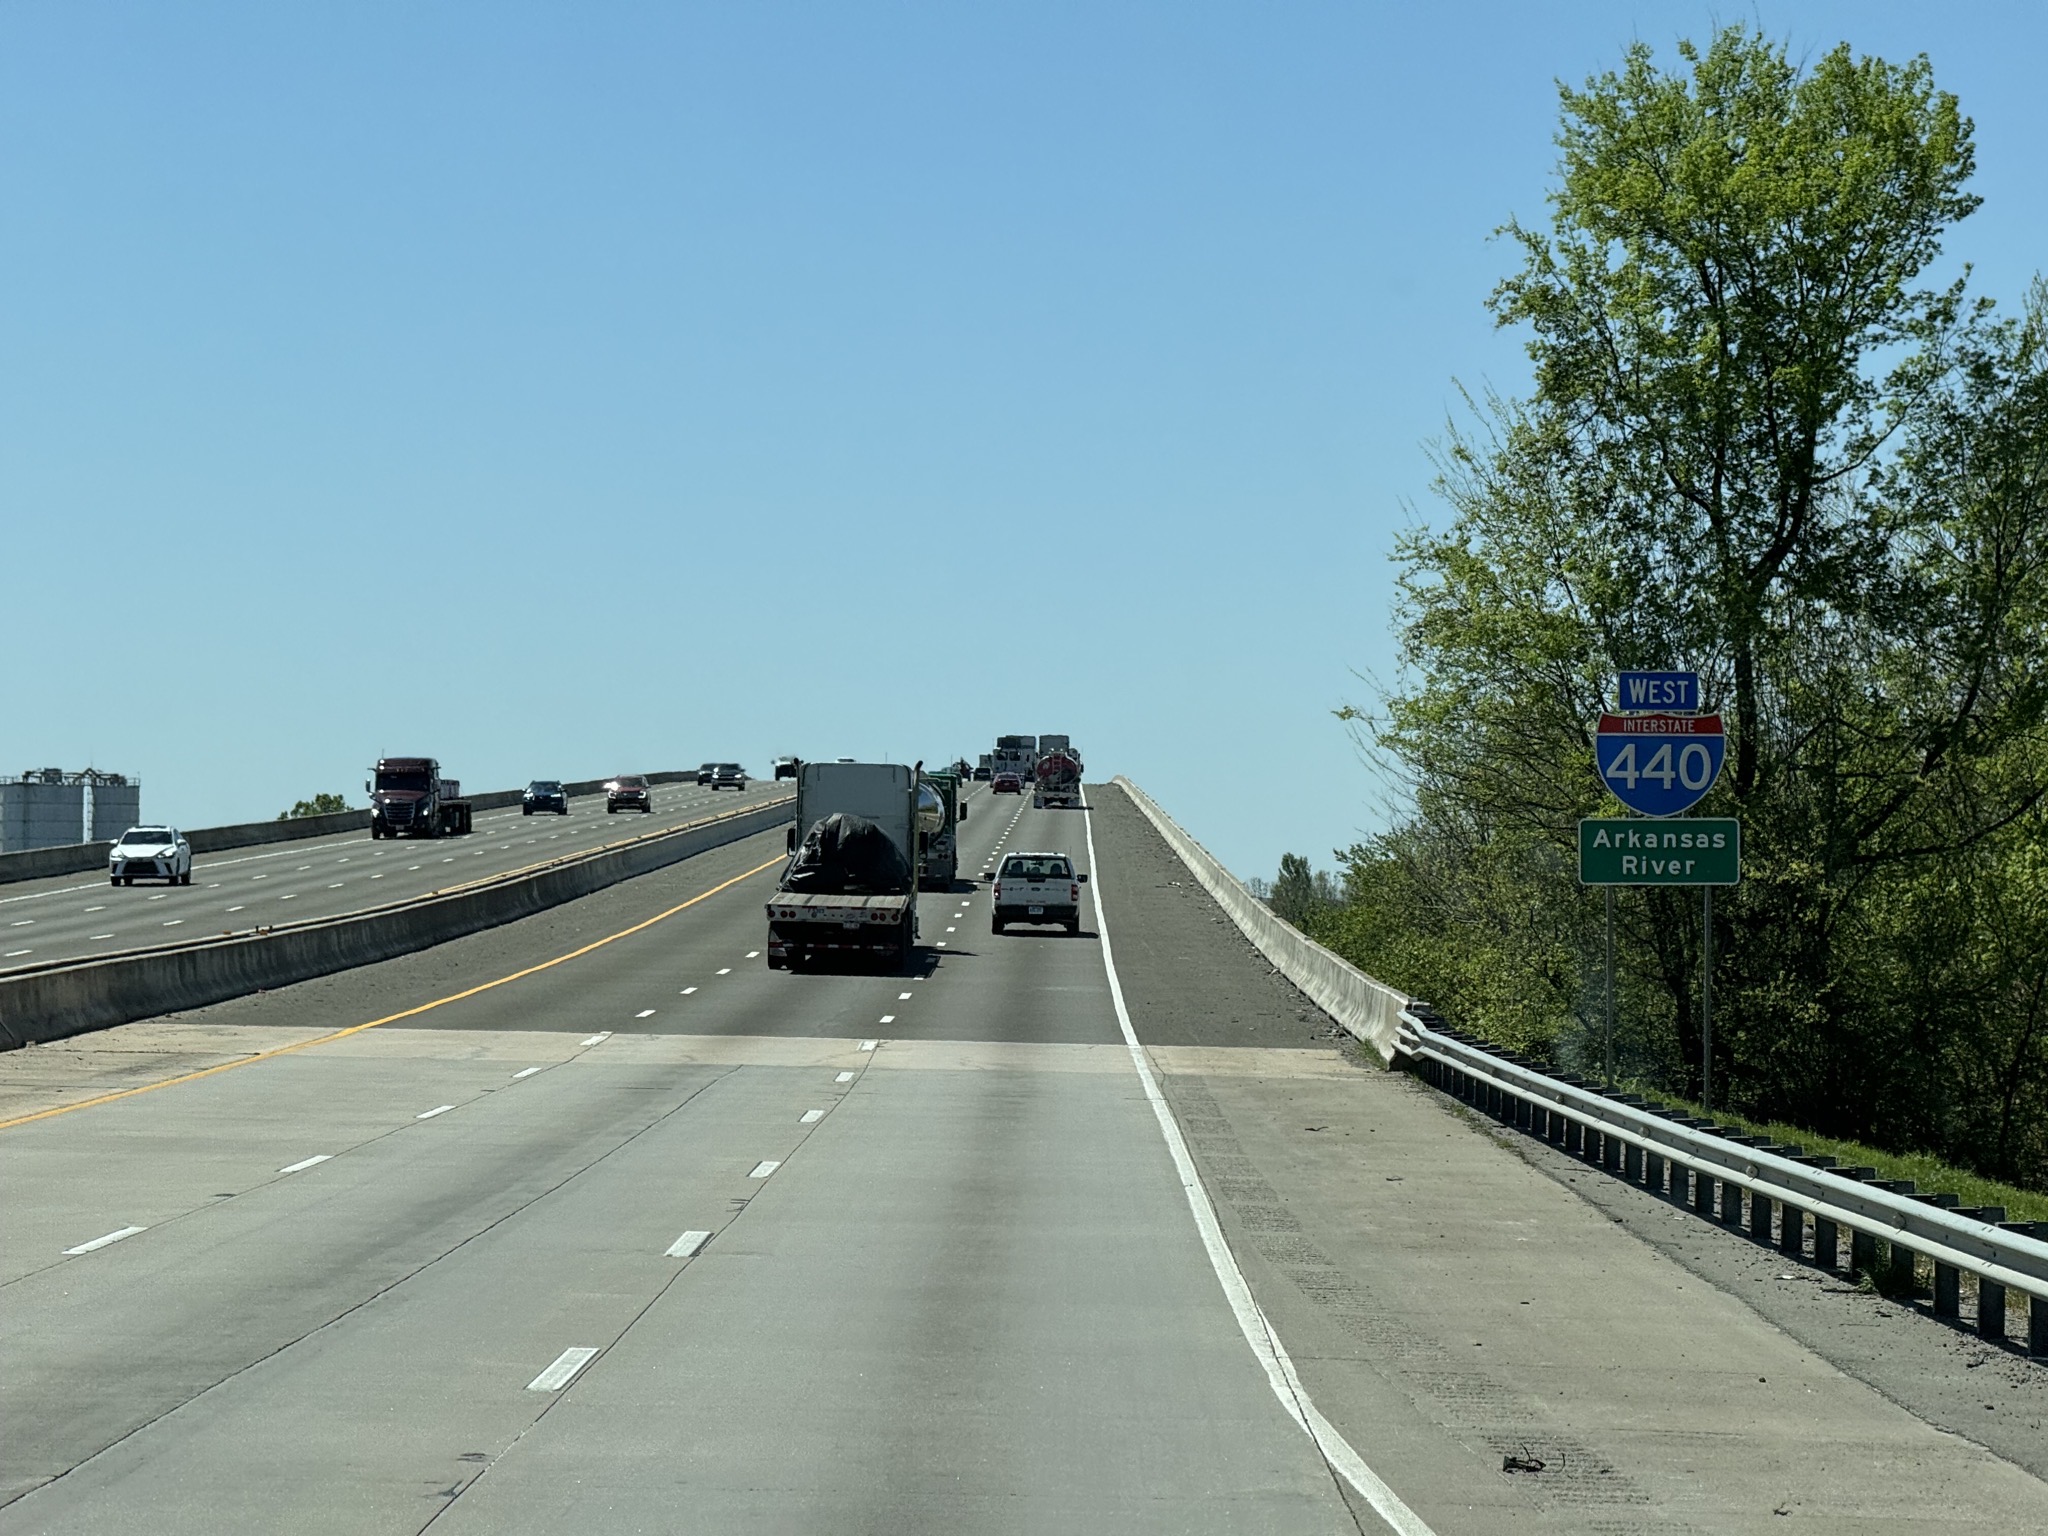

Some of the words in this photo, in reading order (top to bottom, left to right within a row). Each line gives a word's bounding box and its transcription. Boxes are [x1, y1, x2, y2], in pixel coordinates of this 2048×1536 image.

[1629, 679, 1689, 703] WEST
[1623, 719, 1695, 732] INTERSTATE
[1606, 743, 1711, 790] 440
[1593, 828, 1726, 848] Arkansas
[1622, 855, 1695, 875] River
